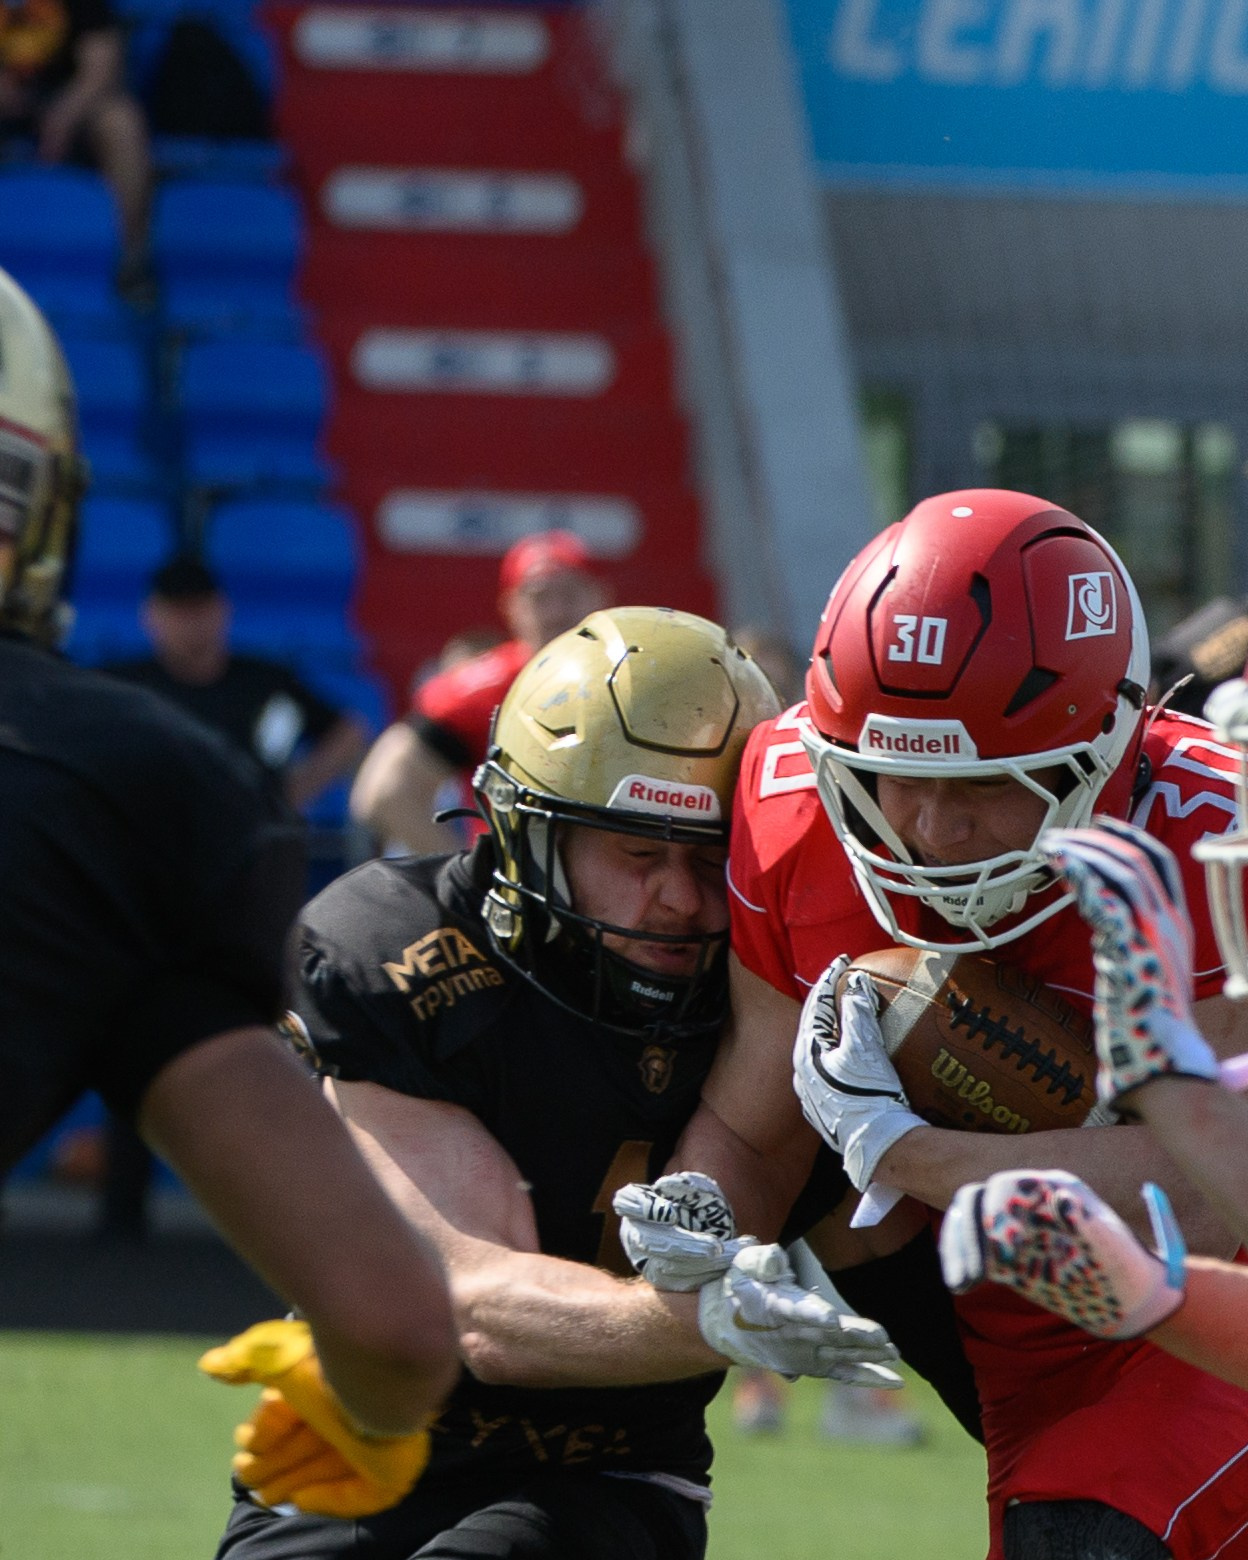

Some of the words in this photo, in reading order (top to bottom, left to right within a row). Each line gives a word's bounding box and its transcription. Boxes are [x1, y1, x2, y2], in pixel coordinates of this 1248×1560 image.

[888, 614, 948, 665] 30
[868, 728, 960, 754] Riddell
[629, 782, 712, 811] Riddell
[942, 896, 984, 907] Riddll
[631, 981, 674, 1001] Riddell
[931, 1048, 1030, 1133] Wilson
